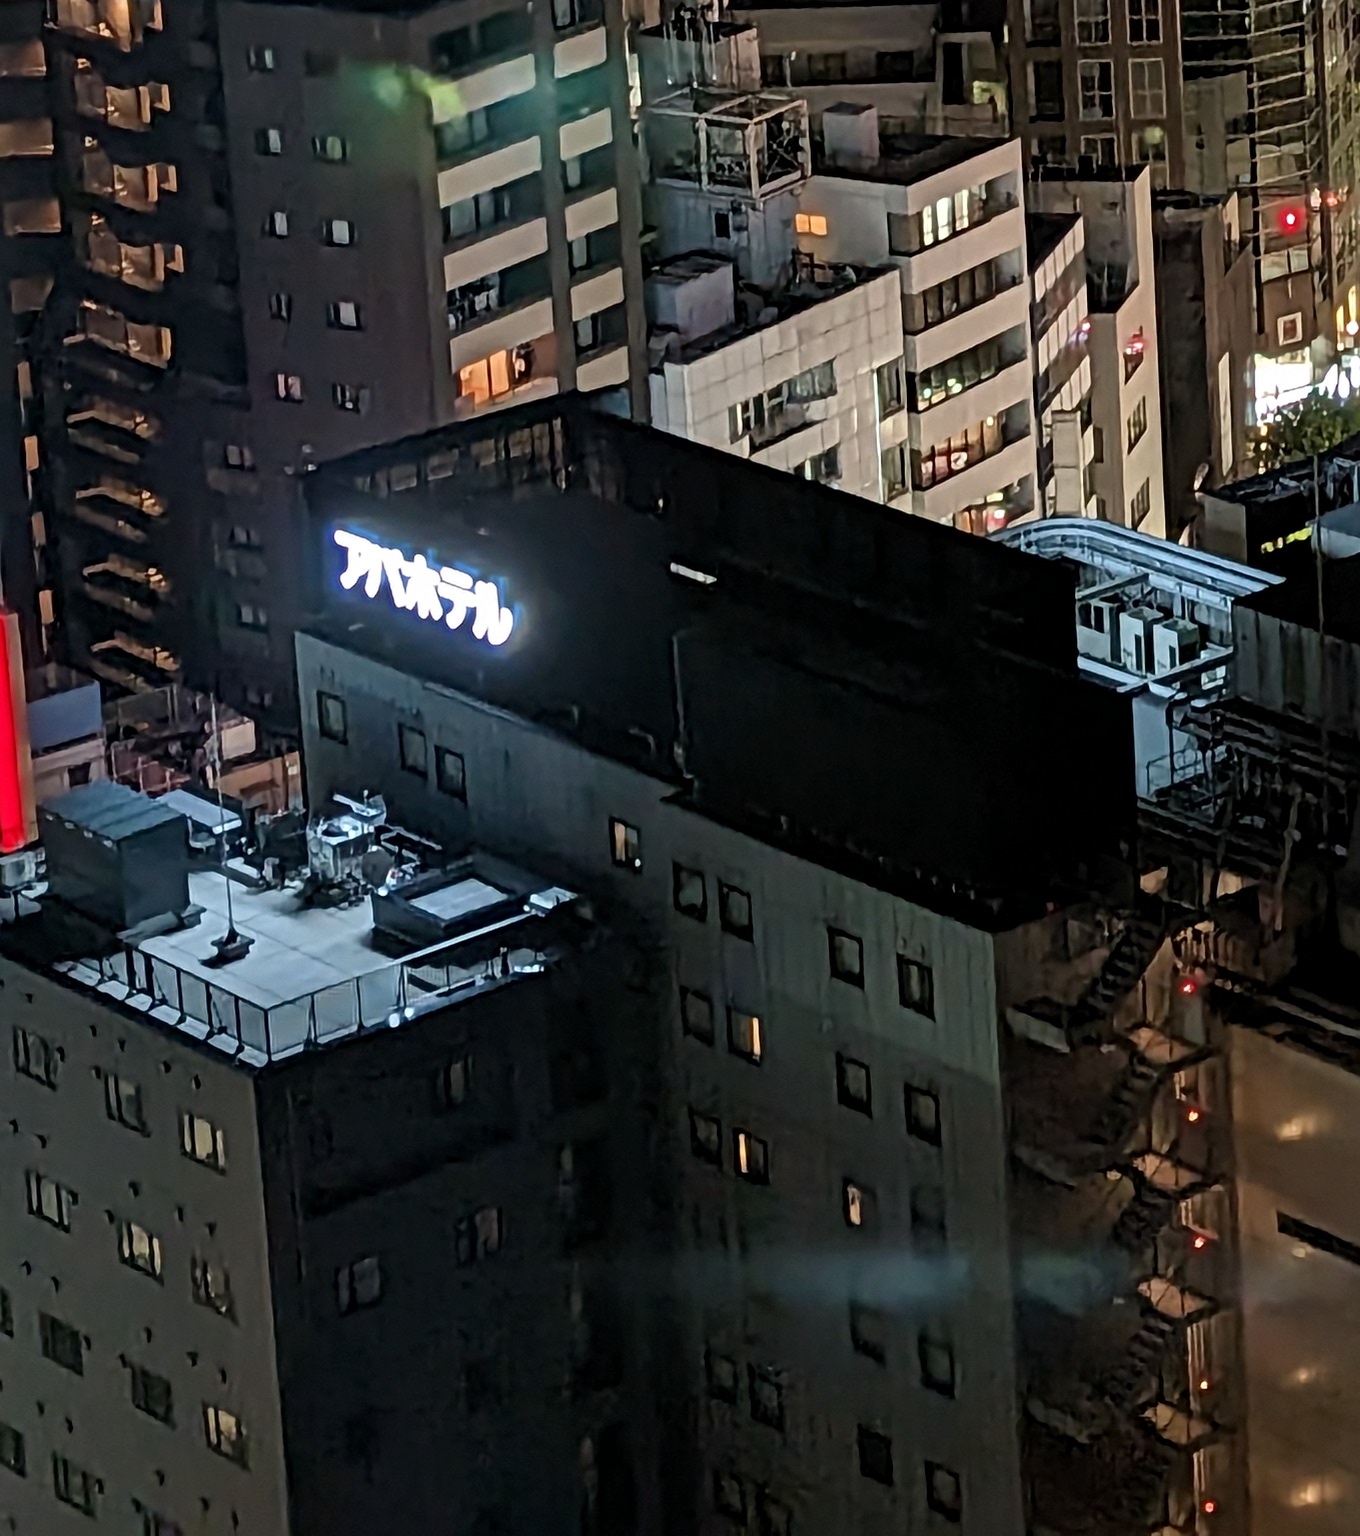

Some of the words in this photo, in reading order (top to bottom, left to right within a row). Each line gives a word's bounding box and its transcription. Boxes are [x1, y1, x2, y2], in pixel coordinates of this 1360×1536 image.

[333, 528, 514, 647] アパホテル
